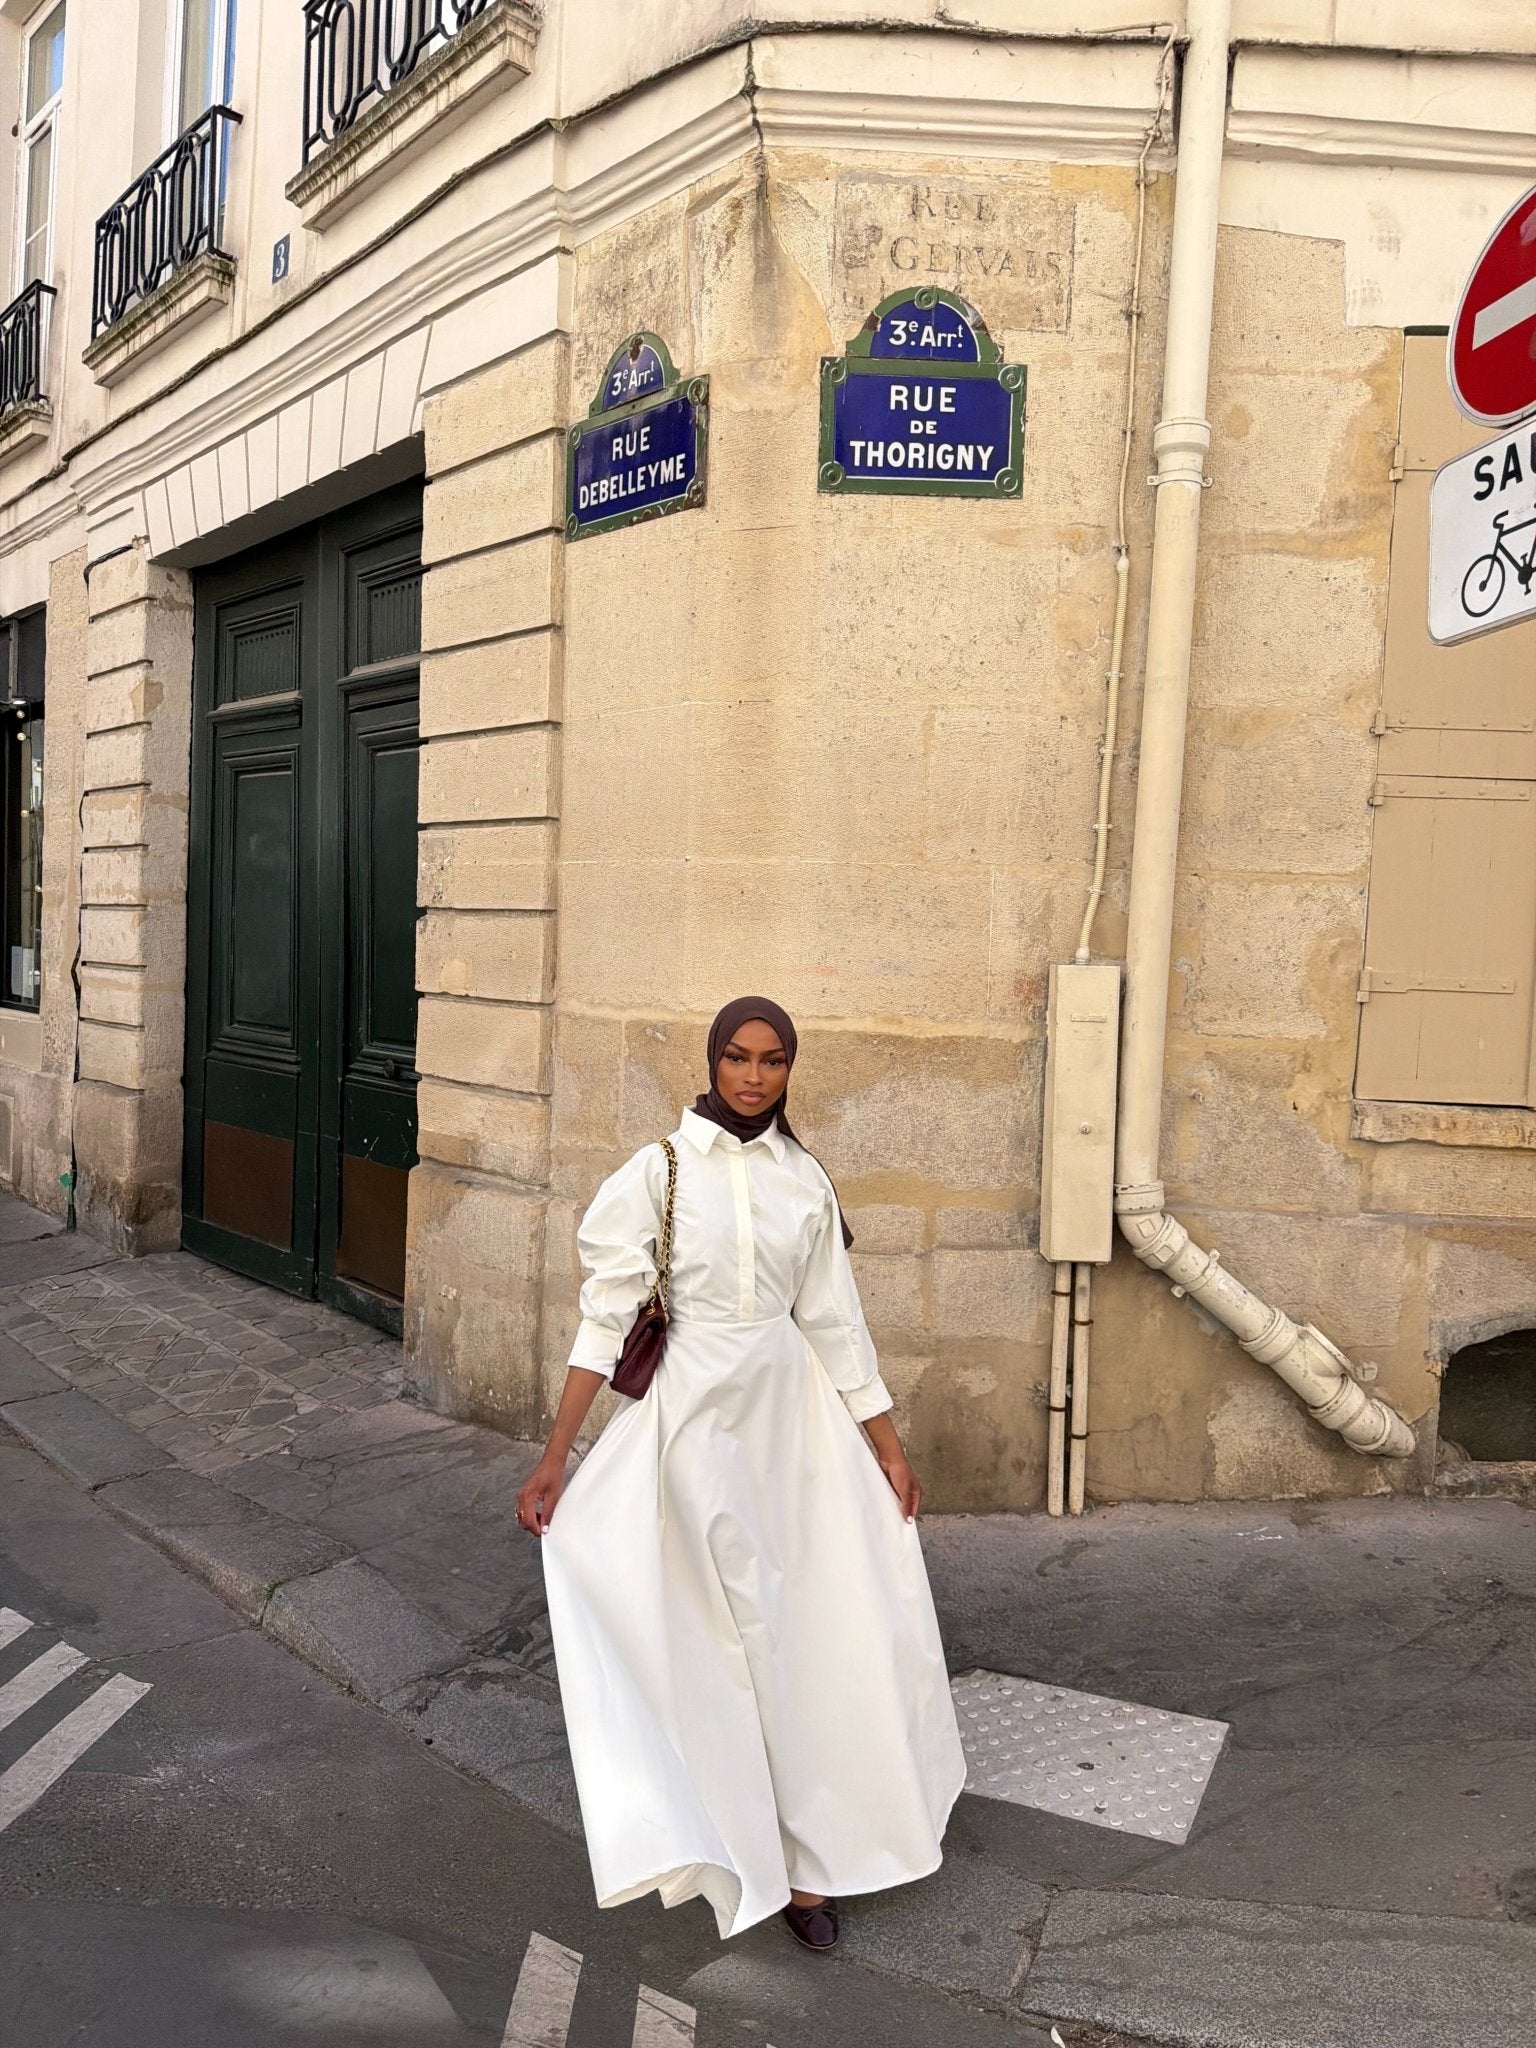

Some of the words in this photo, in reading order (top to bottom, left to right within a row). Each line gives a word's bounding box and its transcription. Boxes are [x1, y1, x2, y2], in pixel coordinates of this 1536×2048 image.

[274, 243, 285, 278] 3
[889, 235, 1064, 279] GERVAIS
[889, 384, 957, 414] RUE
[612, 425, 651, 462] RUE
[909, 419, 938, 435] DE
[849, 440, 995, 471] THORIGNY
[1473, 432, 1536, 501] SA
[579, 453, 686, 510] DEBELLEYME
